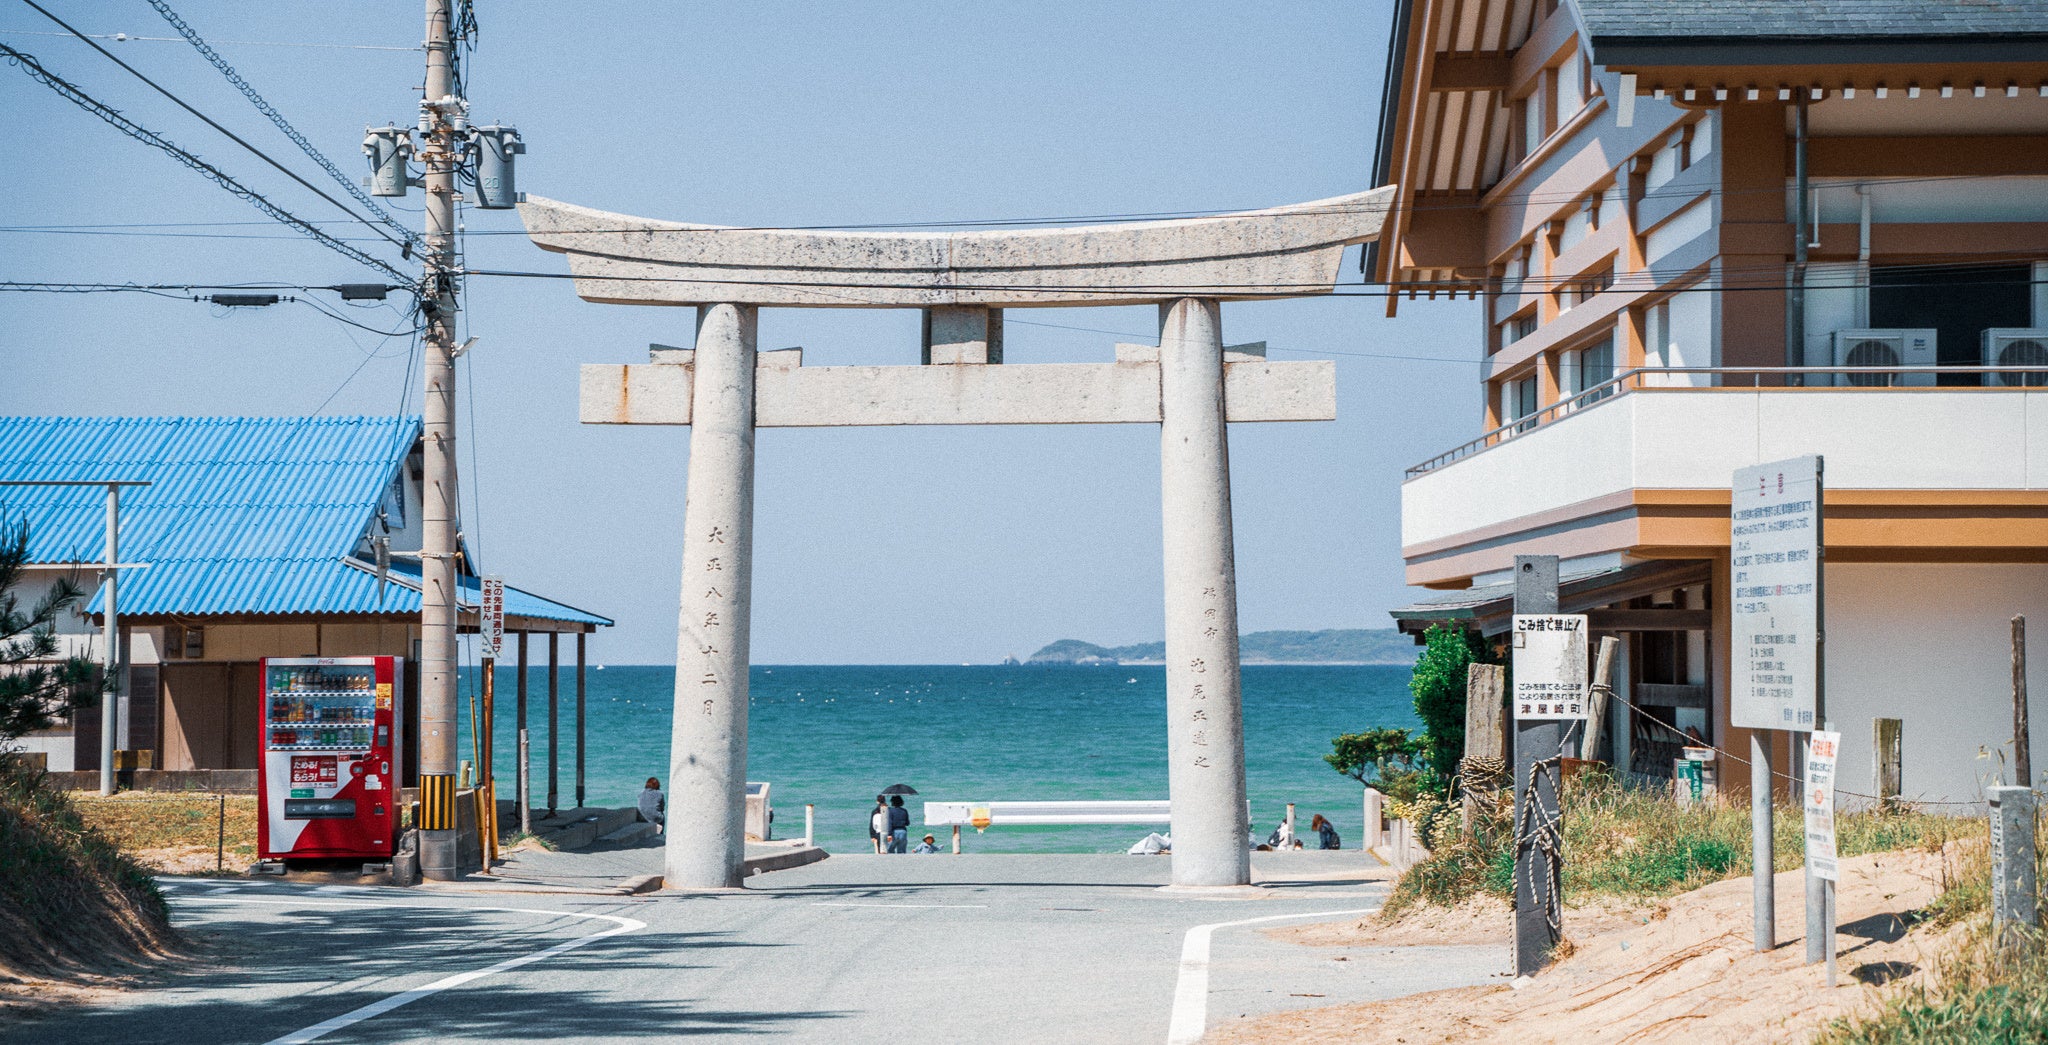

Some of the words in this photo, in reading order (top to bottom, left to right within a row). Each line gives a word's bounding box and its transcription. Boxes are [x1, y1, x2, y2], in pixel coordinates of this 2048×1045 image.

[485, 176, 499, 189] 20
[483, 580, 492, 621] できません
[493, 580, 503, 653] この先車両通り抜け
[702, 526, 725, 716] 大正八年十二月
[1518, 618, 1581, 631] ごみ捨て禁止!
[1518, 683, 1582, 691] ごみを捨てると法律
[1521, 703, 1581, 714] 津屋崎町
